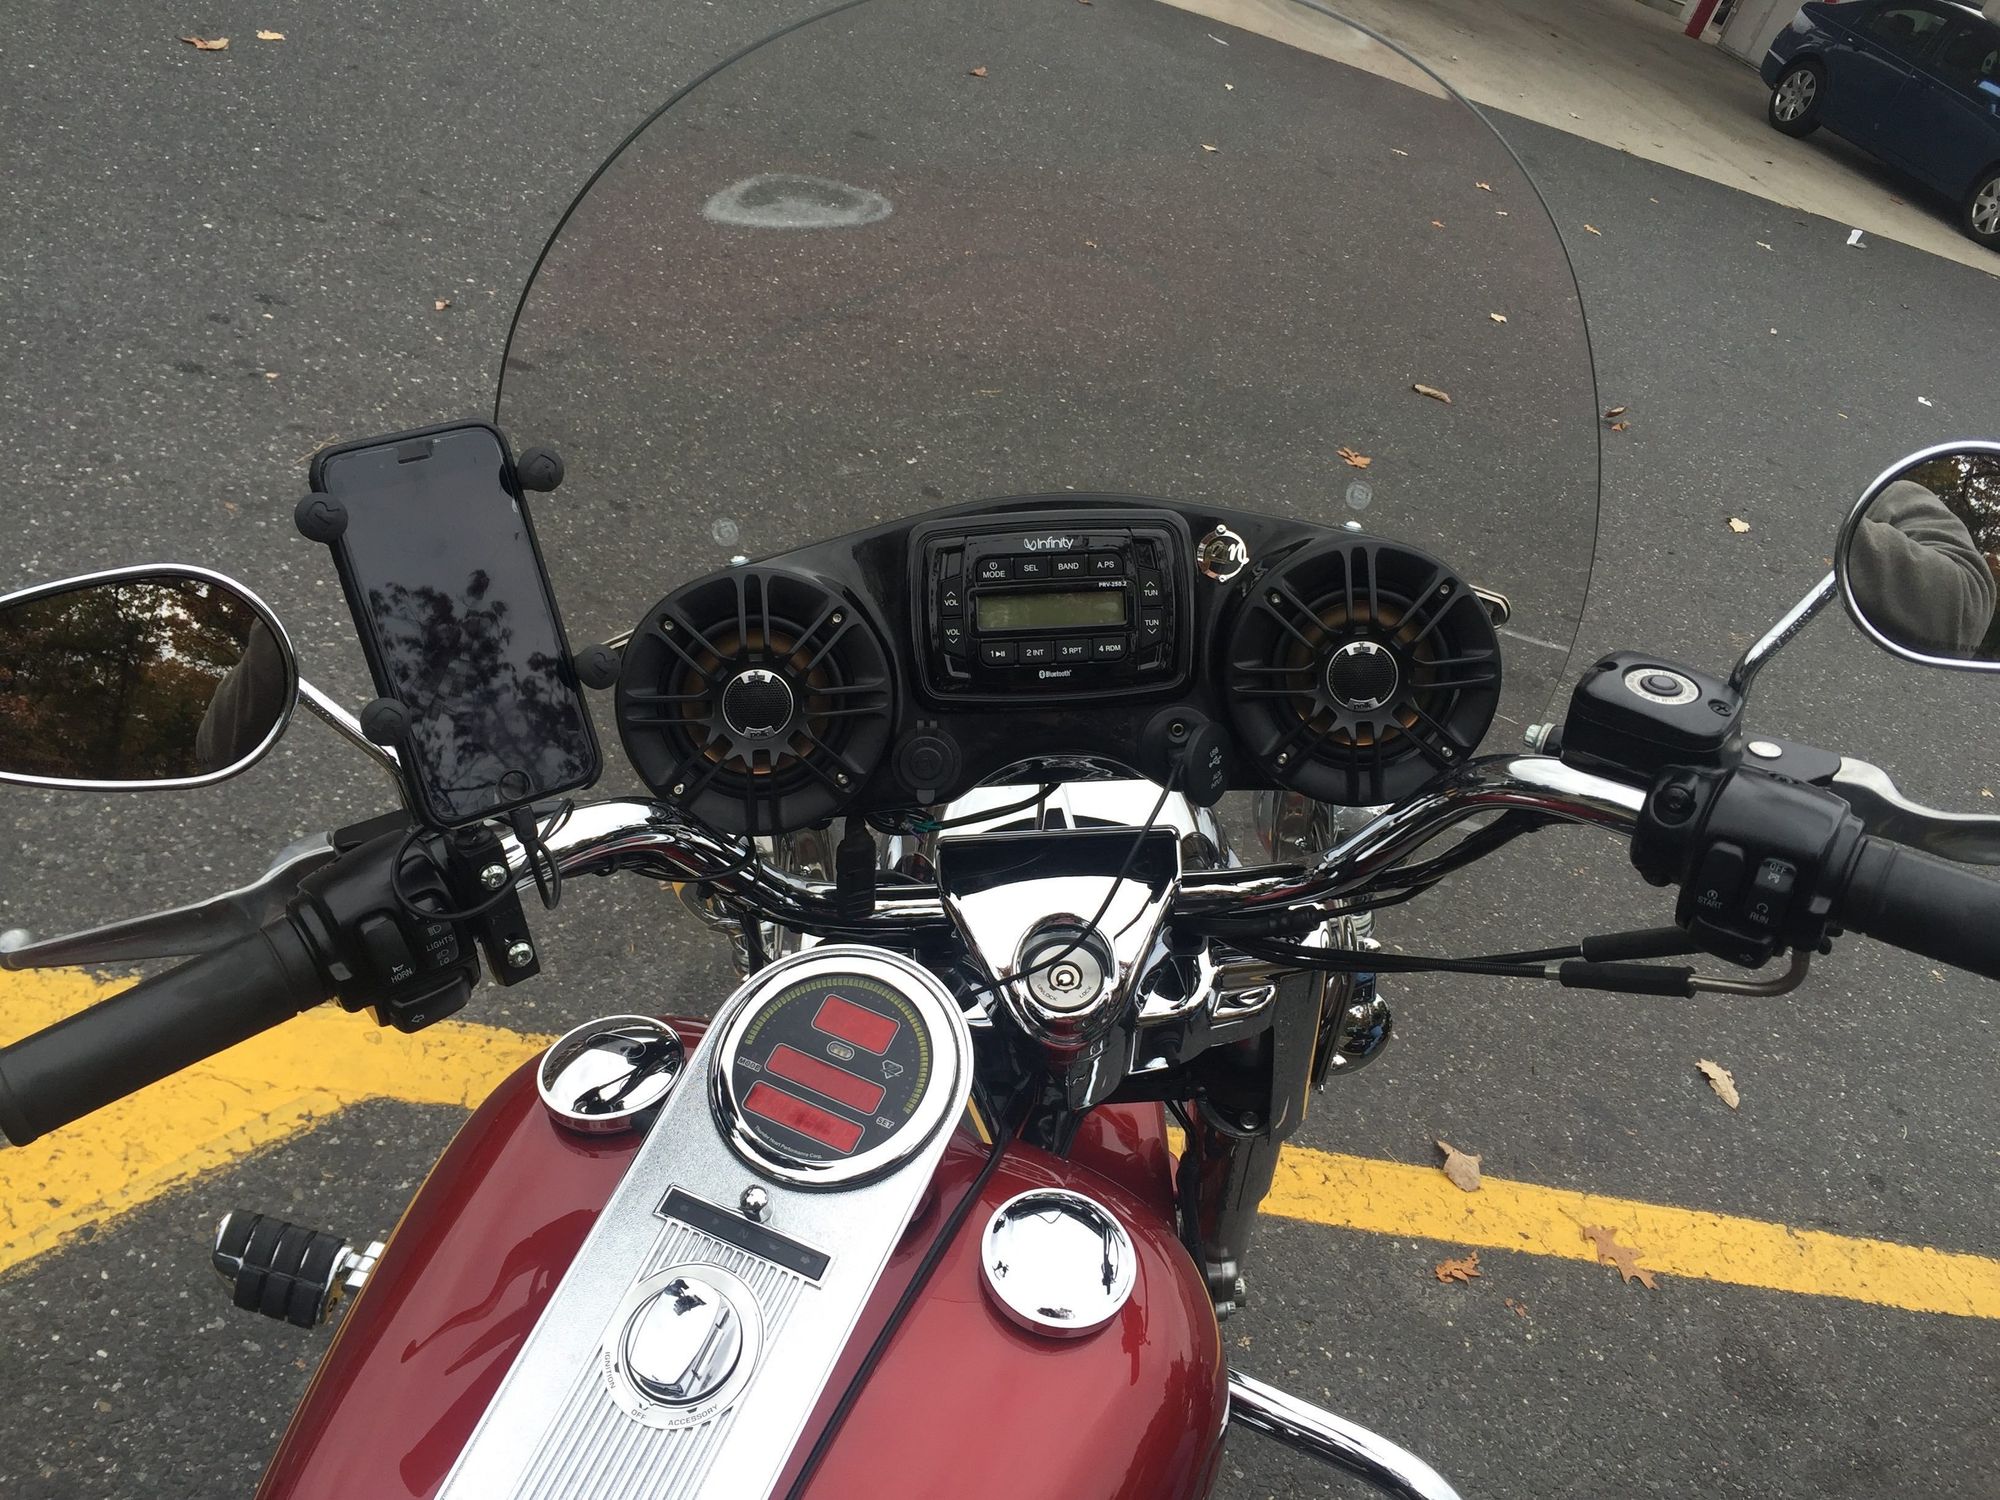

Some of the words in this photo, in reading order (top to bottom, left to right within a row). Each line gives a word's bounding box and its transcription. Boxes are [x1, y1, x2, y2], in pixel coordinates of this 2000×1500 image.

[1023, 564, 1039, 572] SEL
[1058, 562, 1079, 570] BAND
[982, 570, 1006, 578] MODE
[946, 628, 961, 636] VOL
[1062, 647, 1068, 655] 3
[1105, 644, 1121, 652] RDM
[1769, 862, 1786, 874] OFF
[1697, 895, 1723, 909] START
[1749, 911, 1769, 924] RUN
[426, 934, 454, 952] LIGHTS
[390, 967, 413, 983] HORN
[1079, 985, 1093, 999] LOCK
[739, 1057, 761, 1071] MODE
[877, 1117, 894, 1128] SET
[604, 1351, 616, 1389] IGNITION
[630, 1408, 647, 1421] OFF
[667, 1404, 719, 1427] ACCESSORY
